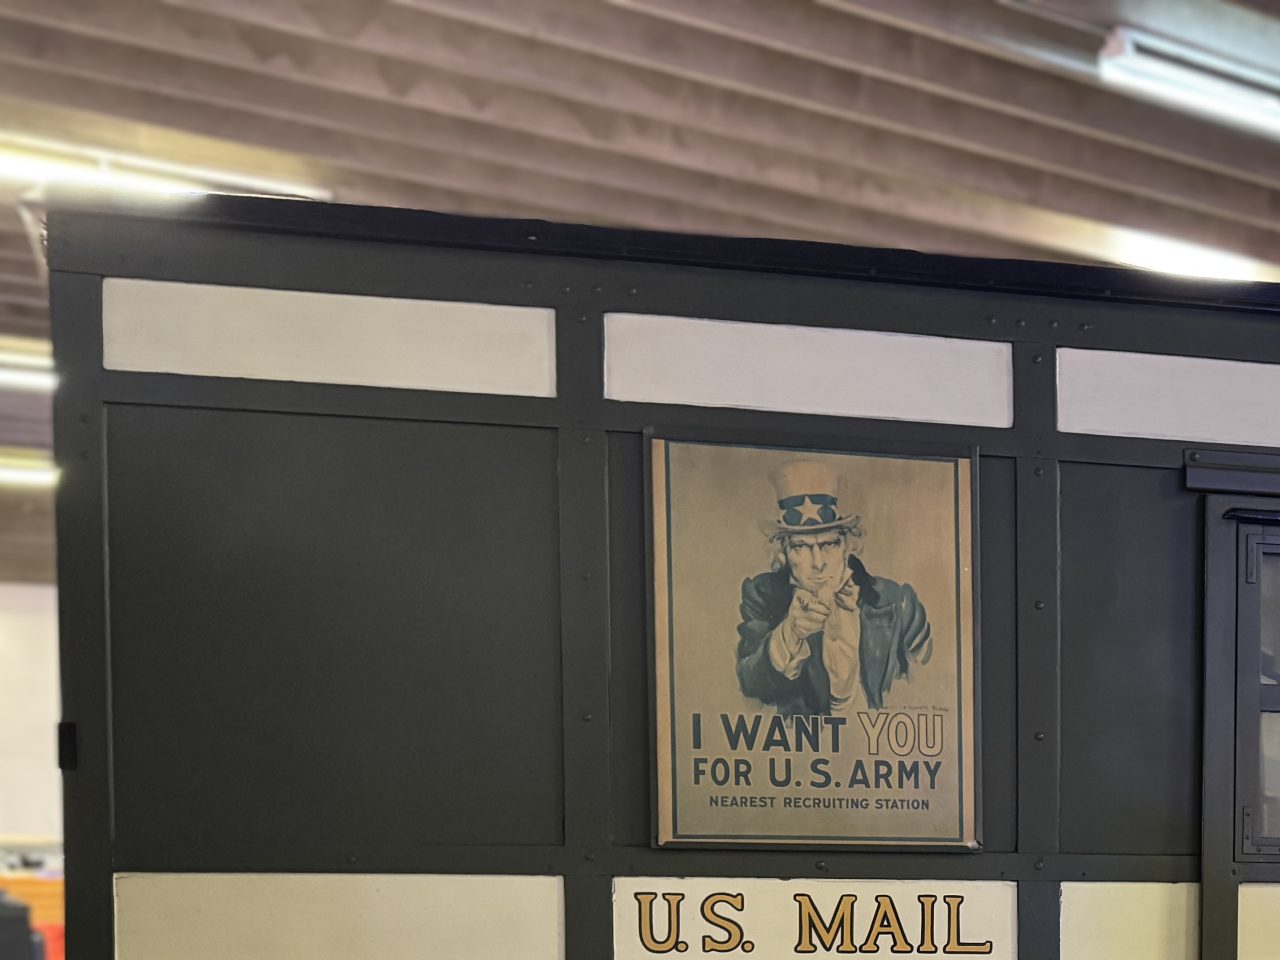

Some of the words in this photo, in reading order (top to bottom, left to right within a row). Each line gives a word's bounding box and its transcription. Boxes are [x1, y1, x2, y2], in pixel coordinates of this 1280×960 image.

[692, 713, 701, 749] I
[720, 713, 847, 753] WANT
[856, 711, 944, 757] YOU
[693, 758, 752, 786] FOR
[709, 796, 776, 808] NEAREST
[783, 797, 869, 809] RECRUITING
[875, 799, 930, 810] STATION
[633, 892, 755, 953] U.S.
[793, 894, 993, 954] MAIL
